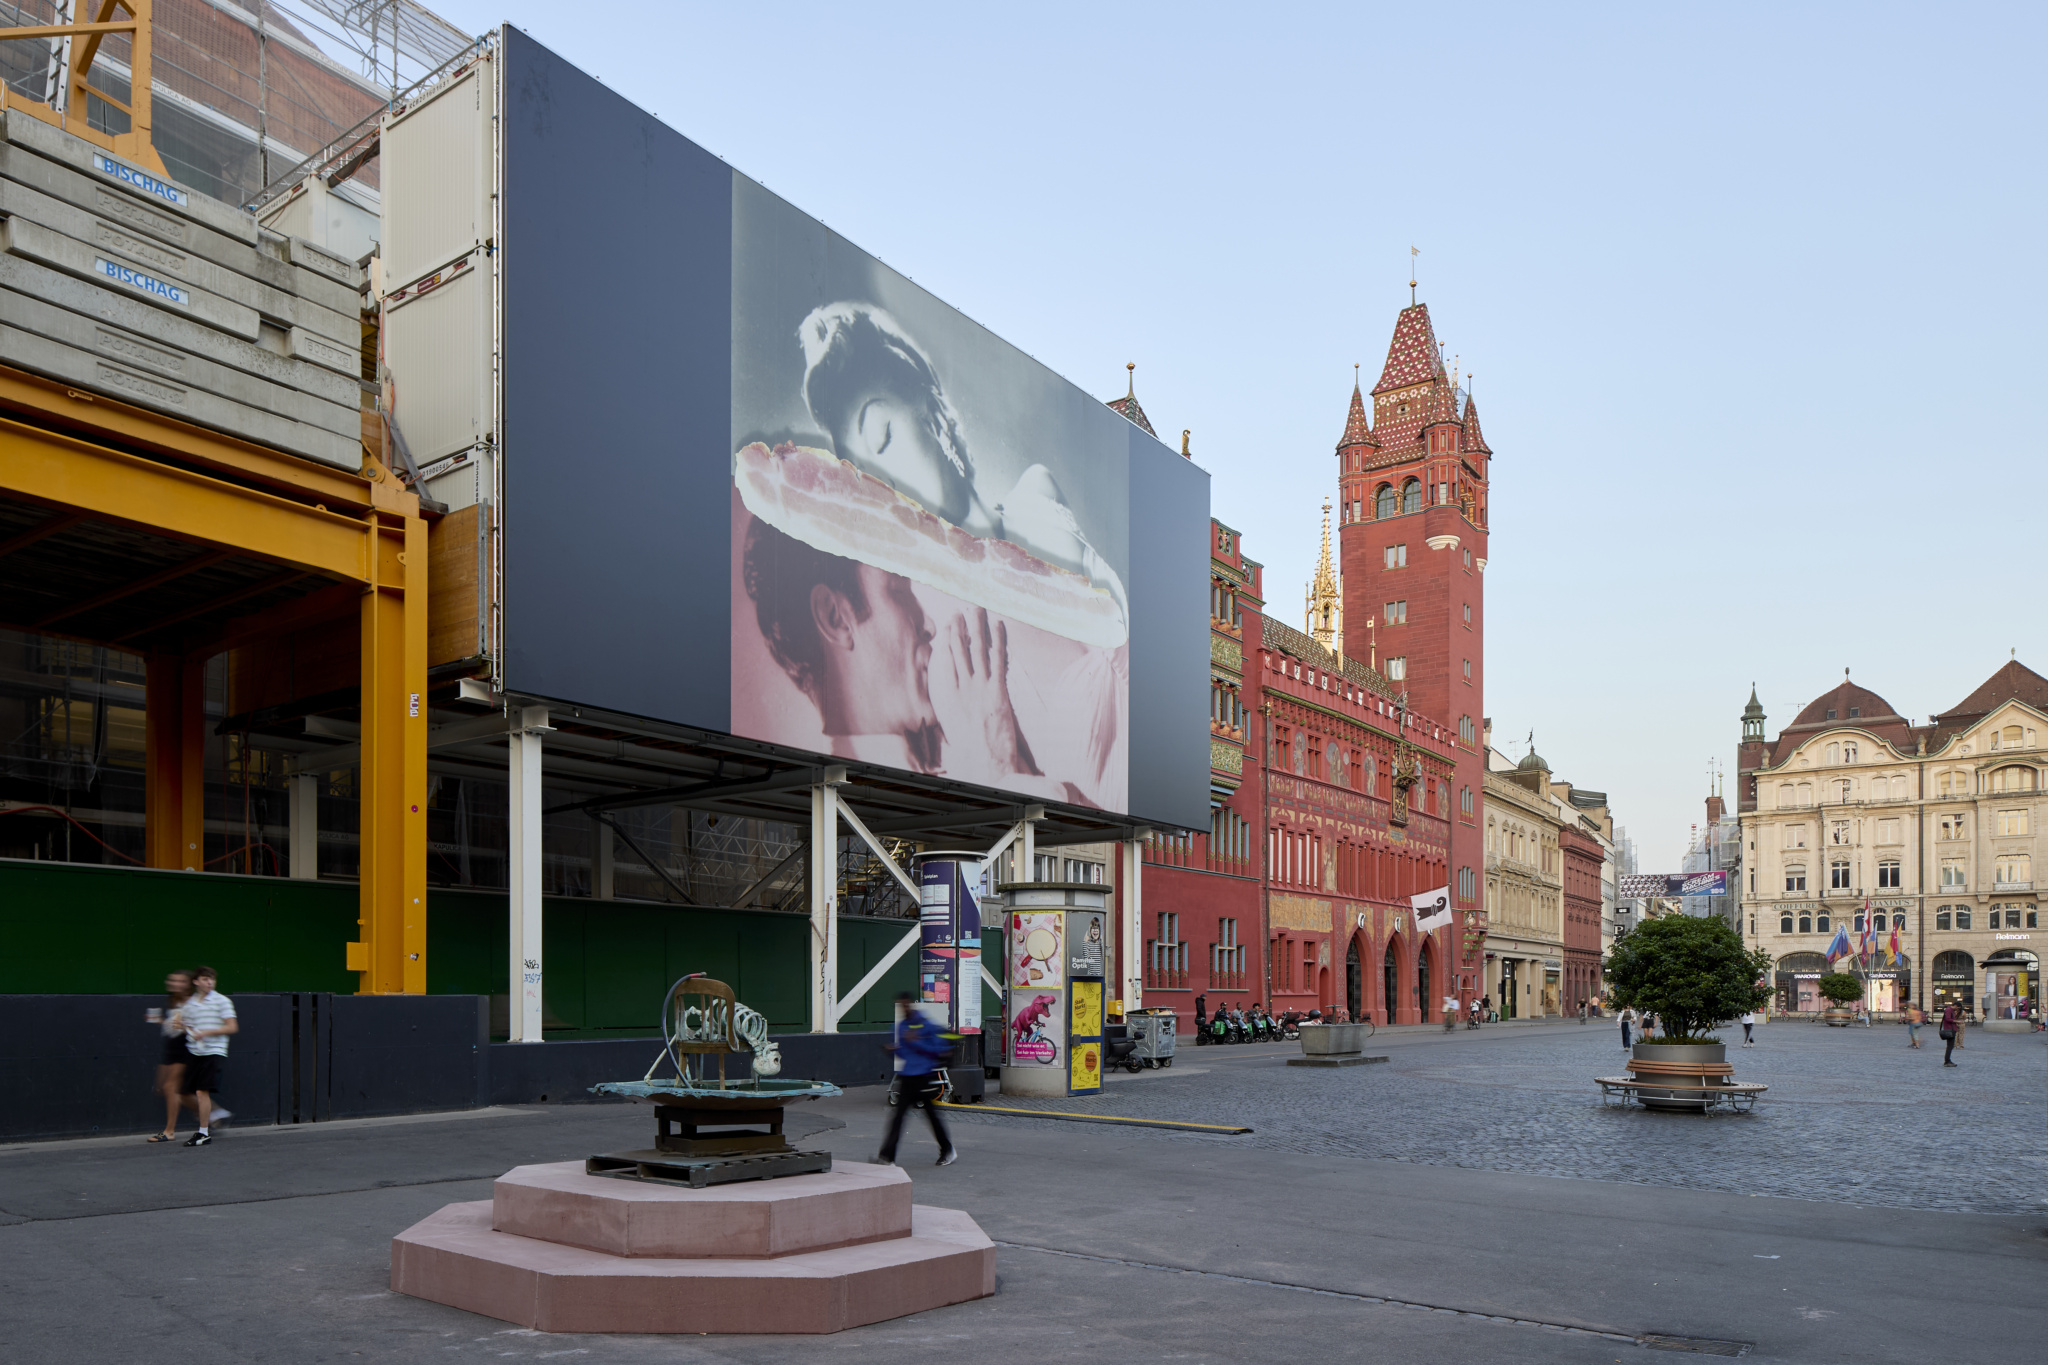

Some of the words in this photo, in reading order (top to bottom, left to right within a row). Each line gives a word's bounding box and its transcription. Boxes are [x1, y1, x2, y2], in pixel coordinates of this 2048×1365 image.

[104, 158, 177, 202] BISCHAG
[105, 261, 179, 301] BISCHAG
[1773, 902, 1817, 910] COIFFURE
[1869, 899, 1910, 907] MAXIM'S
